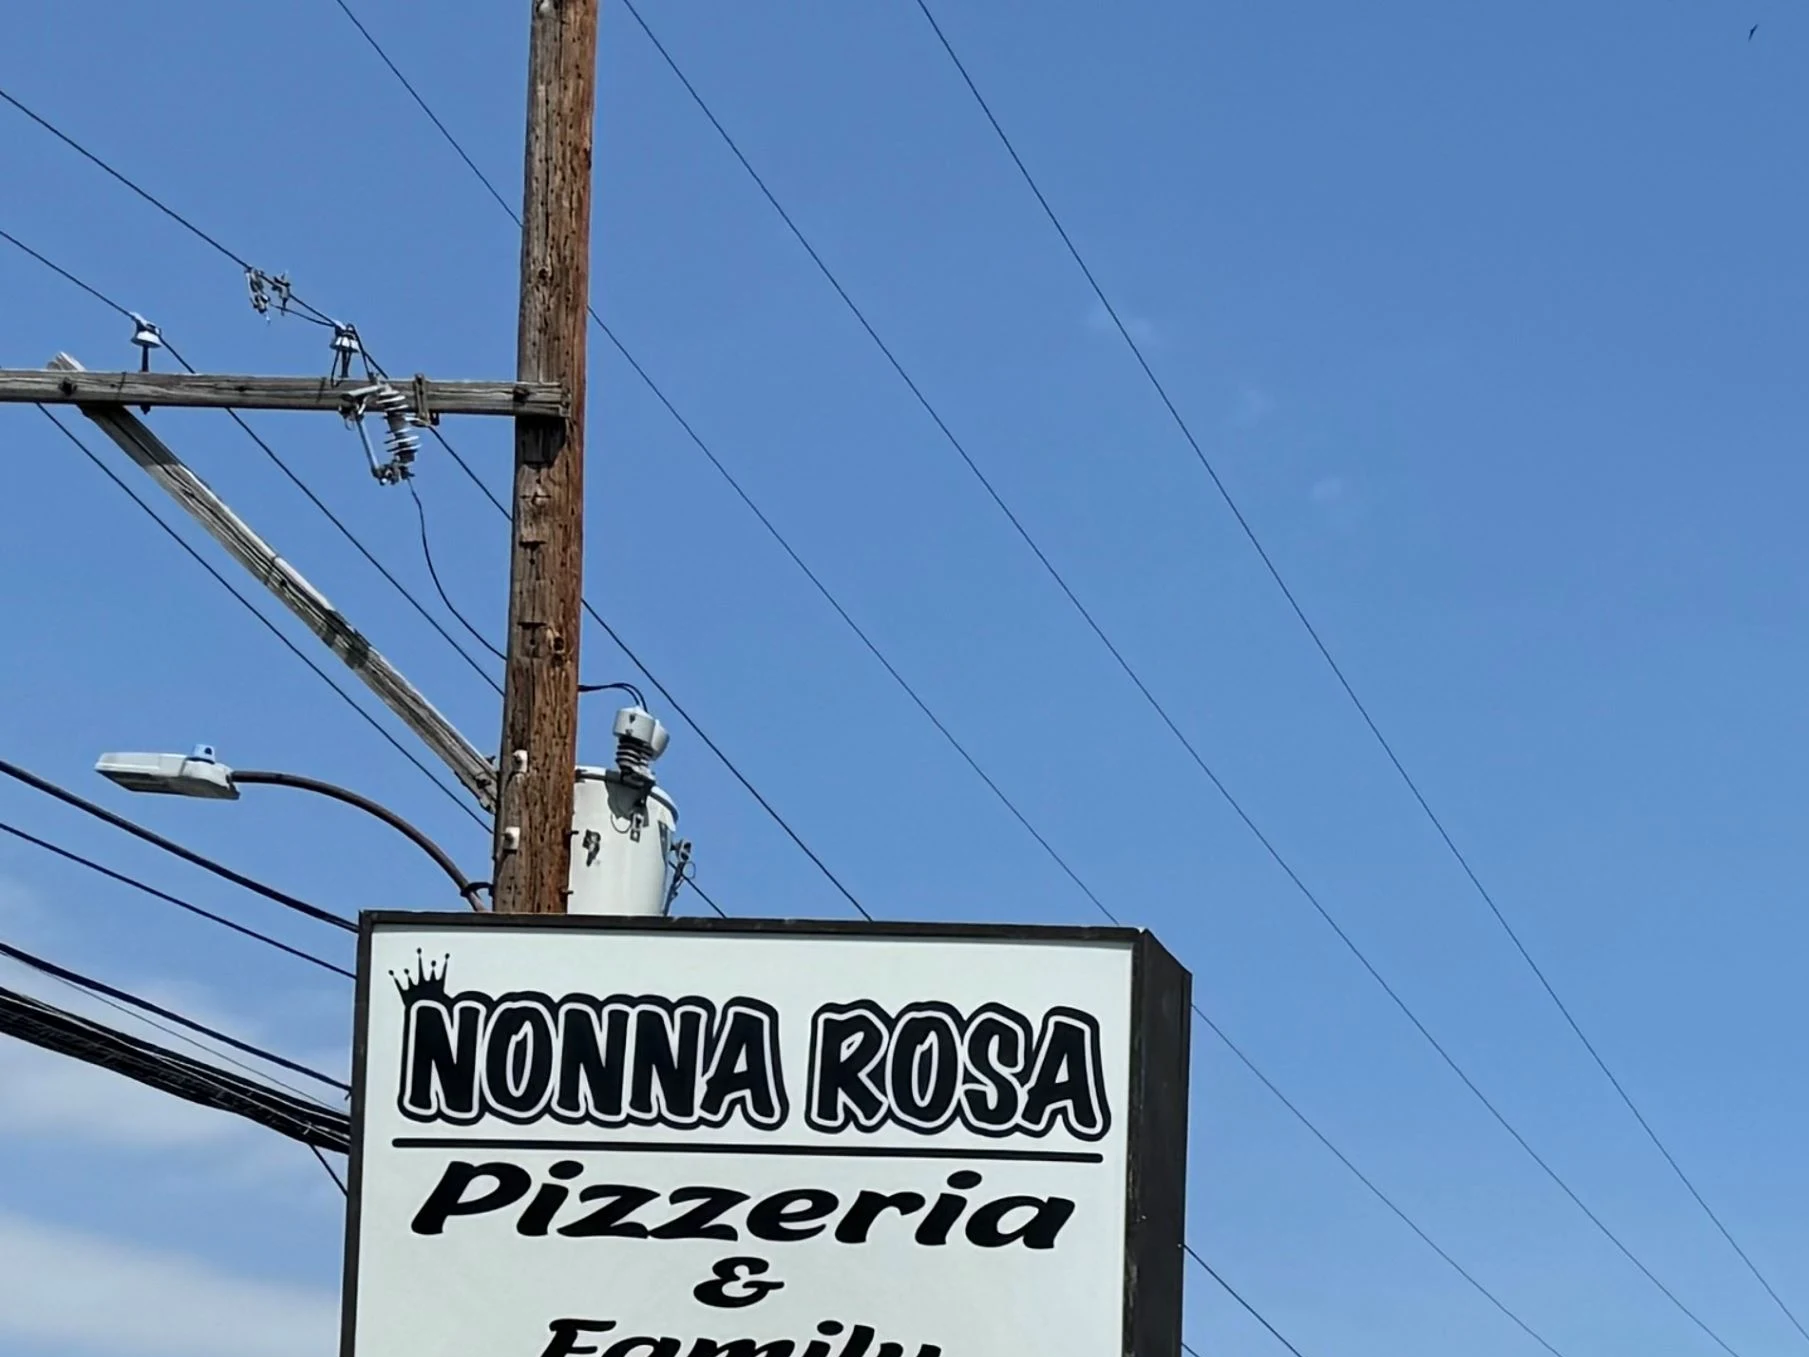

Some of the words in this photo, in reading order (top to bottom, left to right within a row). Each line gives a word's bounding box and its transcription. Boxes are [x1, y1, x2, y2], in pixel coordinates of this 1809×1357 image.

[398, 993, 789, 1130] NONNA
[804, 1001, 1112, 1142] ROSA
[411, 1160, 1076, 1250] Pizzeria
[693, 1256, 785, 1309] &
